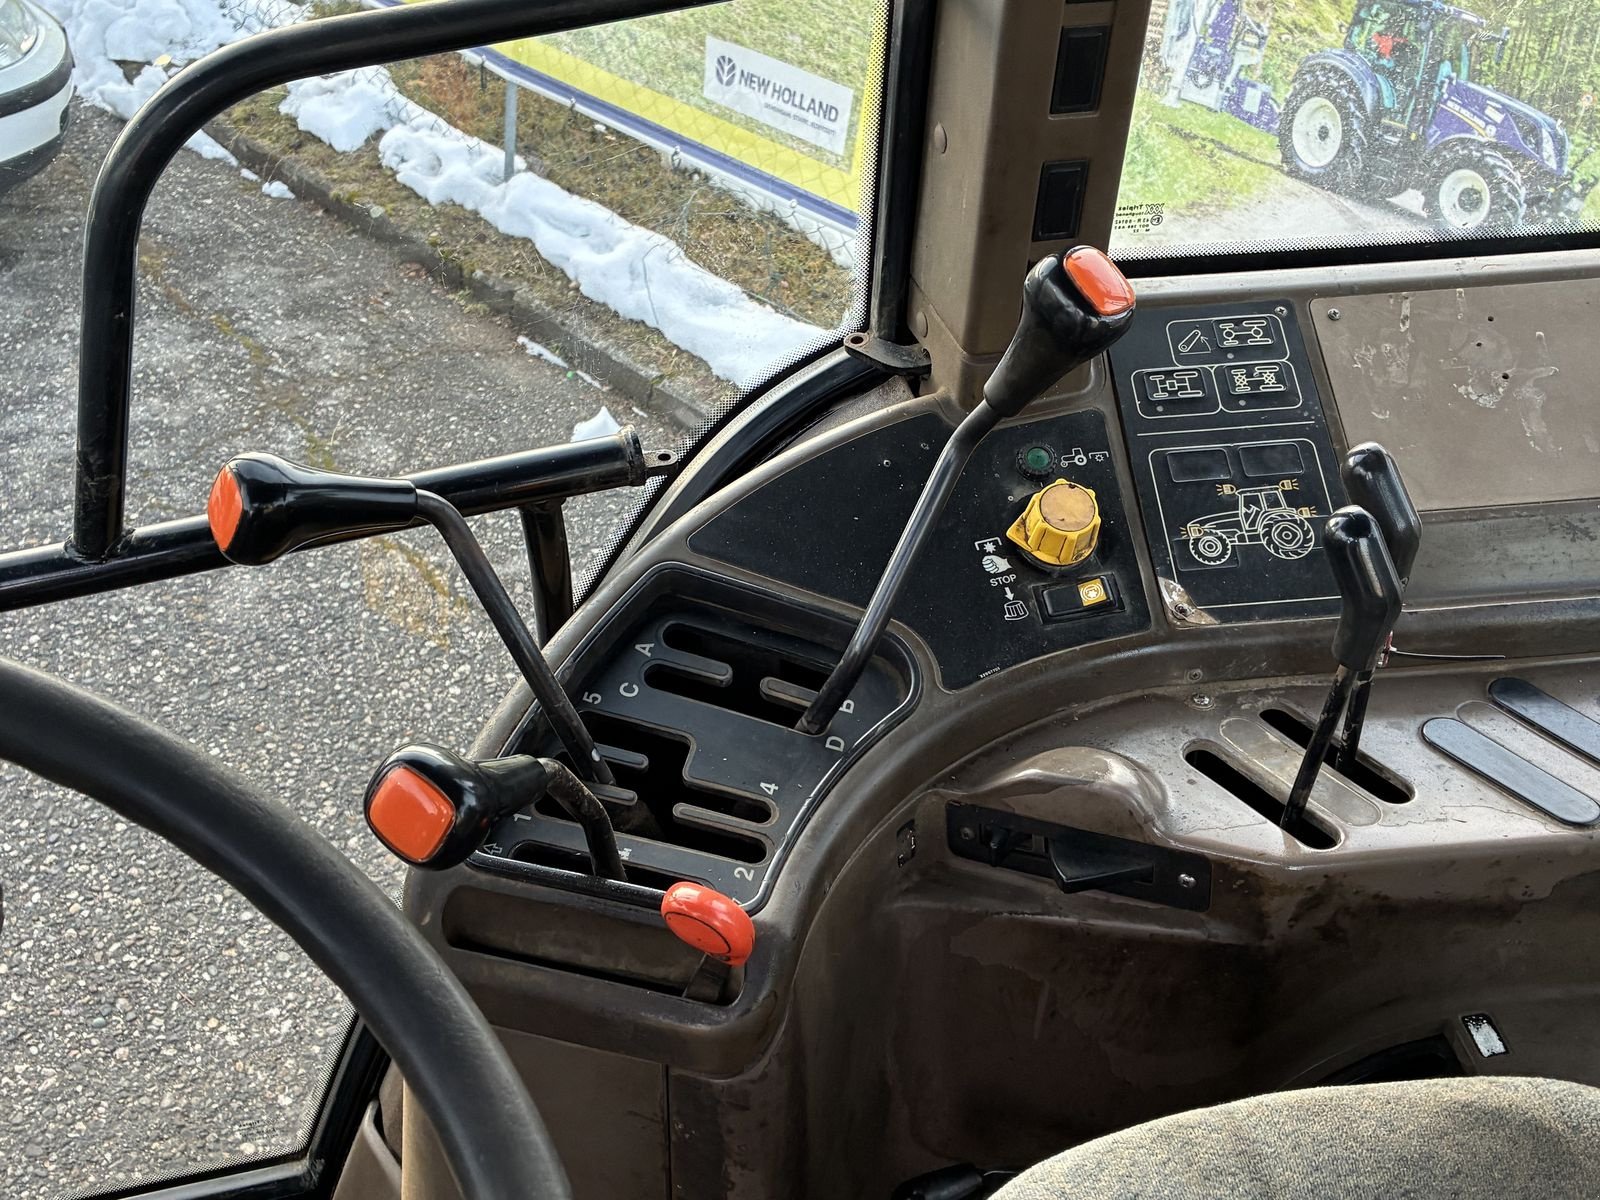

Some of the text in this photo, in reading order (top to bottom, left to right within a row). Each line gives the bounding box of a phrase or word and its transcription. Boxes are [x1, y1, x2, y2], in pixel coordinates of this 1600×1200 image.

[739, 69, 771, 95] NEW
[771, 82, 839, 123] HOLLAND
[990, 574, 1017, 587] STOP
[634, 643, 655, 658] A
[619, 682, 639, 698] C
[582, 691, 602, 705] 5
[825, 735, 845, 752] D
[759, 782, 779, 796] 4
[513, 813, 532, 822] 1
[733, 866, 755, 881] 2
